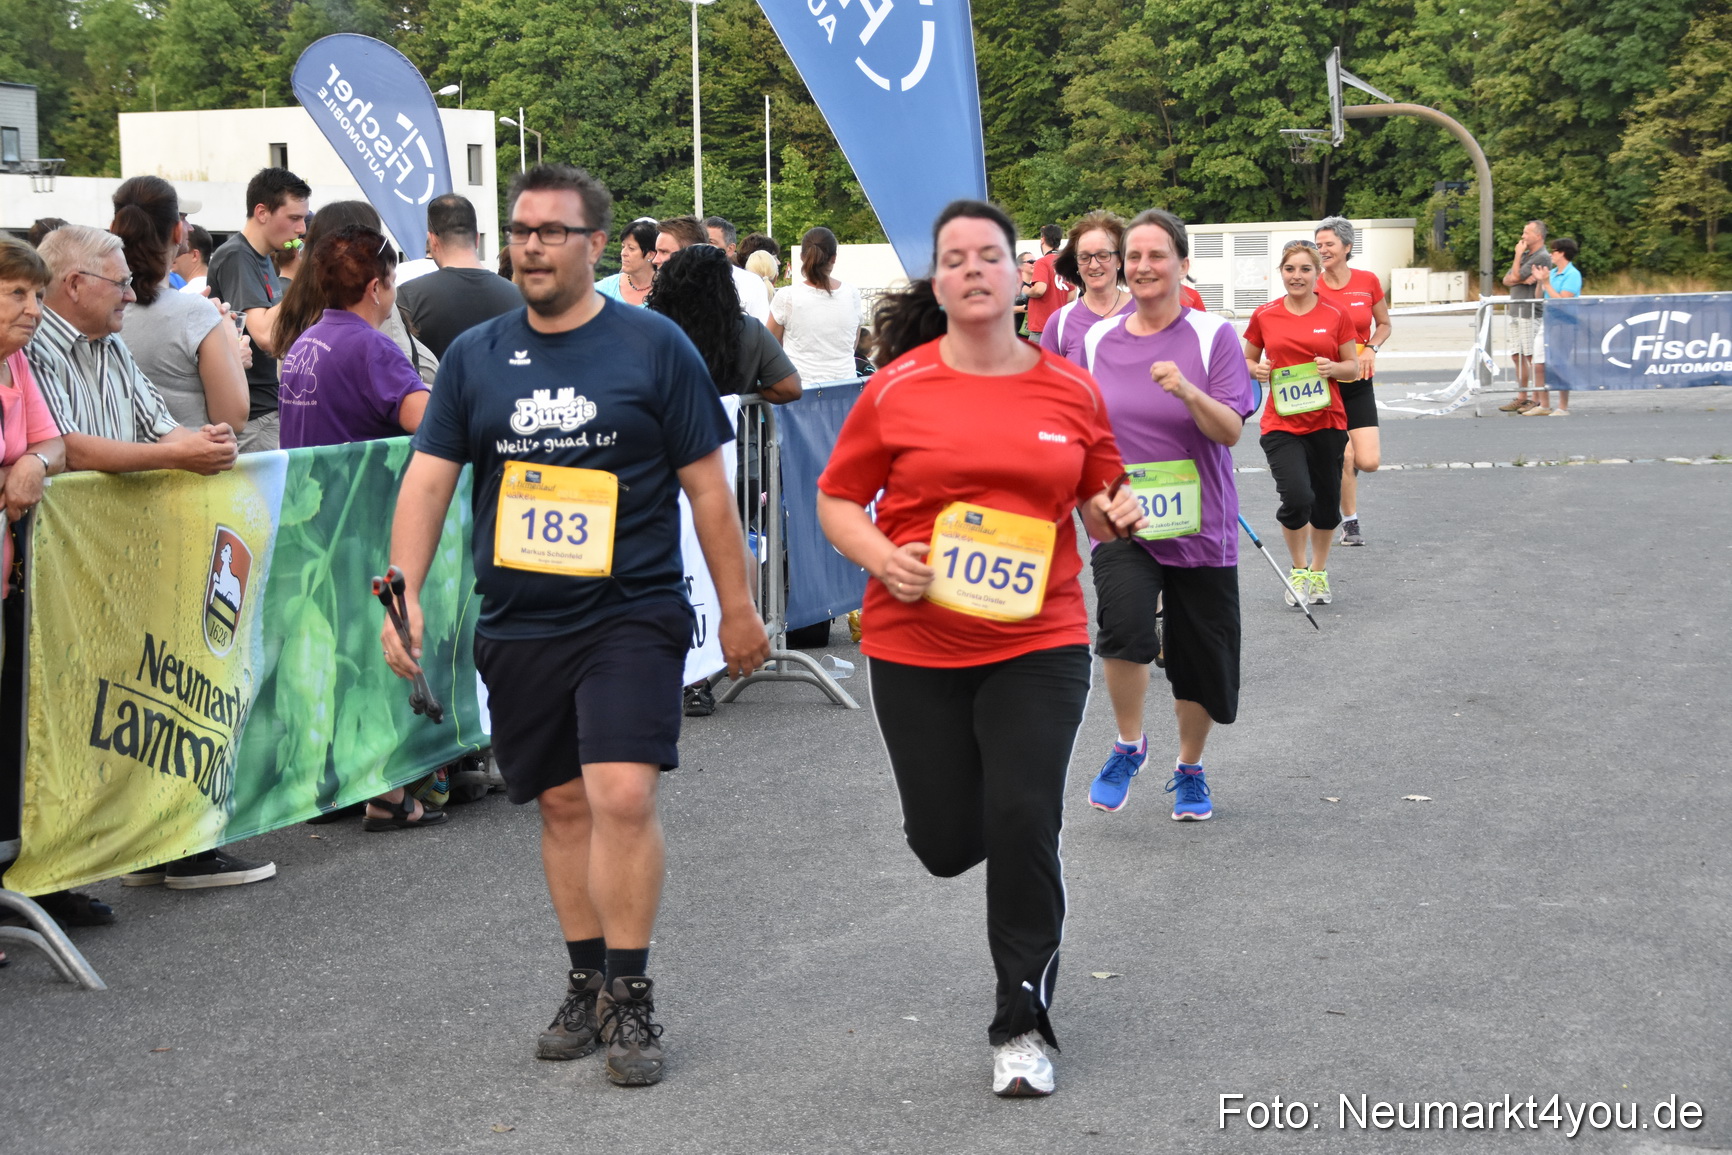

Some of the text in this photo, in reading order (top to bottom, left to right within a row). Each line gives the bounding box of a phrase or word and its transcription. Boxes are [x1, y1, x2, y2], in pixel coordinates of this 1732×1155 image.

[1632, 332, 1732, 361] Fisch
[1279, 380, 1324, 402] 1044
[510, 395, 597, 436] Burgis
[496, 430, 617, 454] Weil's guad is!
[521, 507, 589, 546] 183
[521, 547, 583, 560] Markus Schönfeld
[943, 546, 1036, 595] 1055
[210, 620, 228, 648] 1628
[136, 632, 250, 742] Neumark
